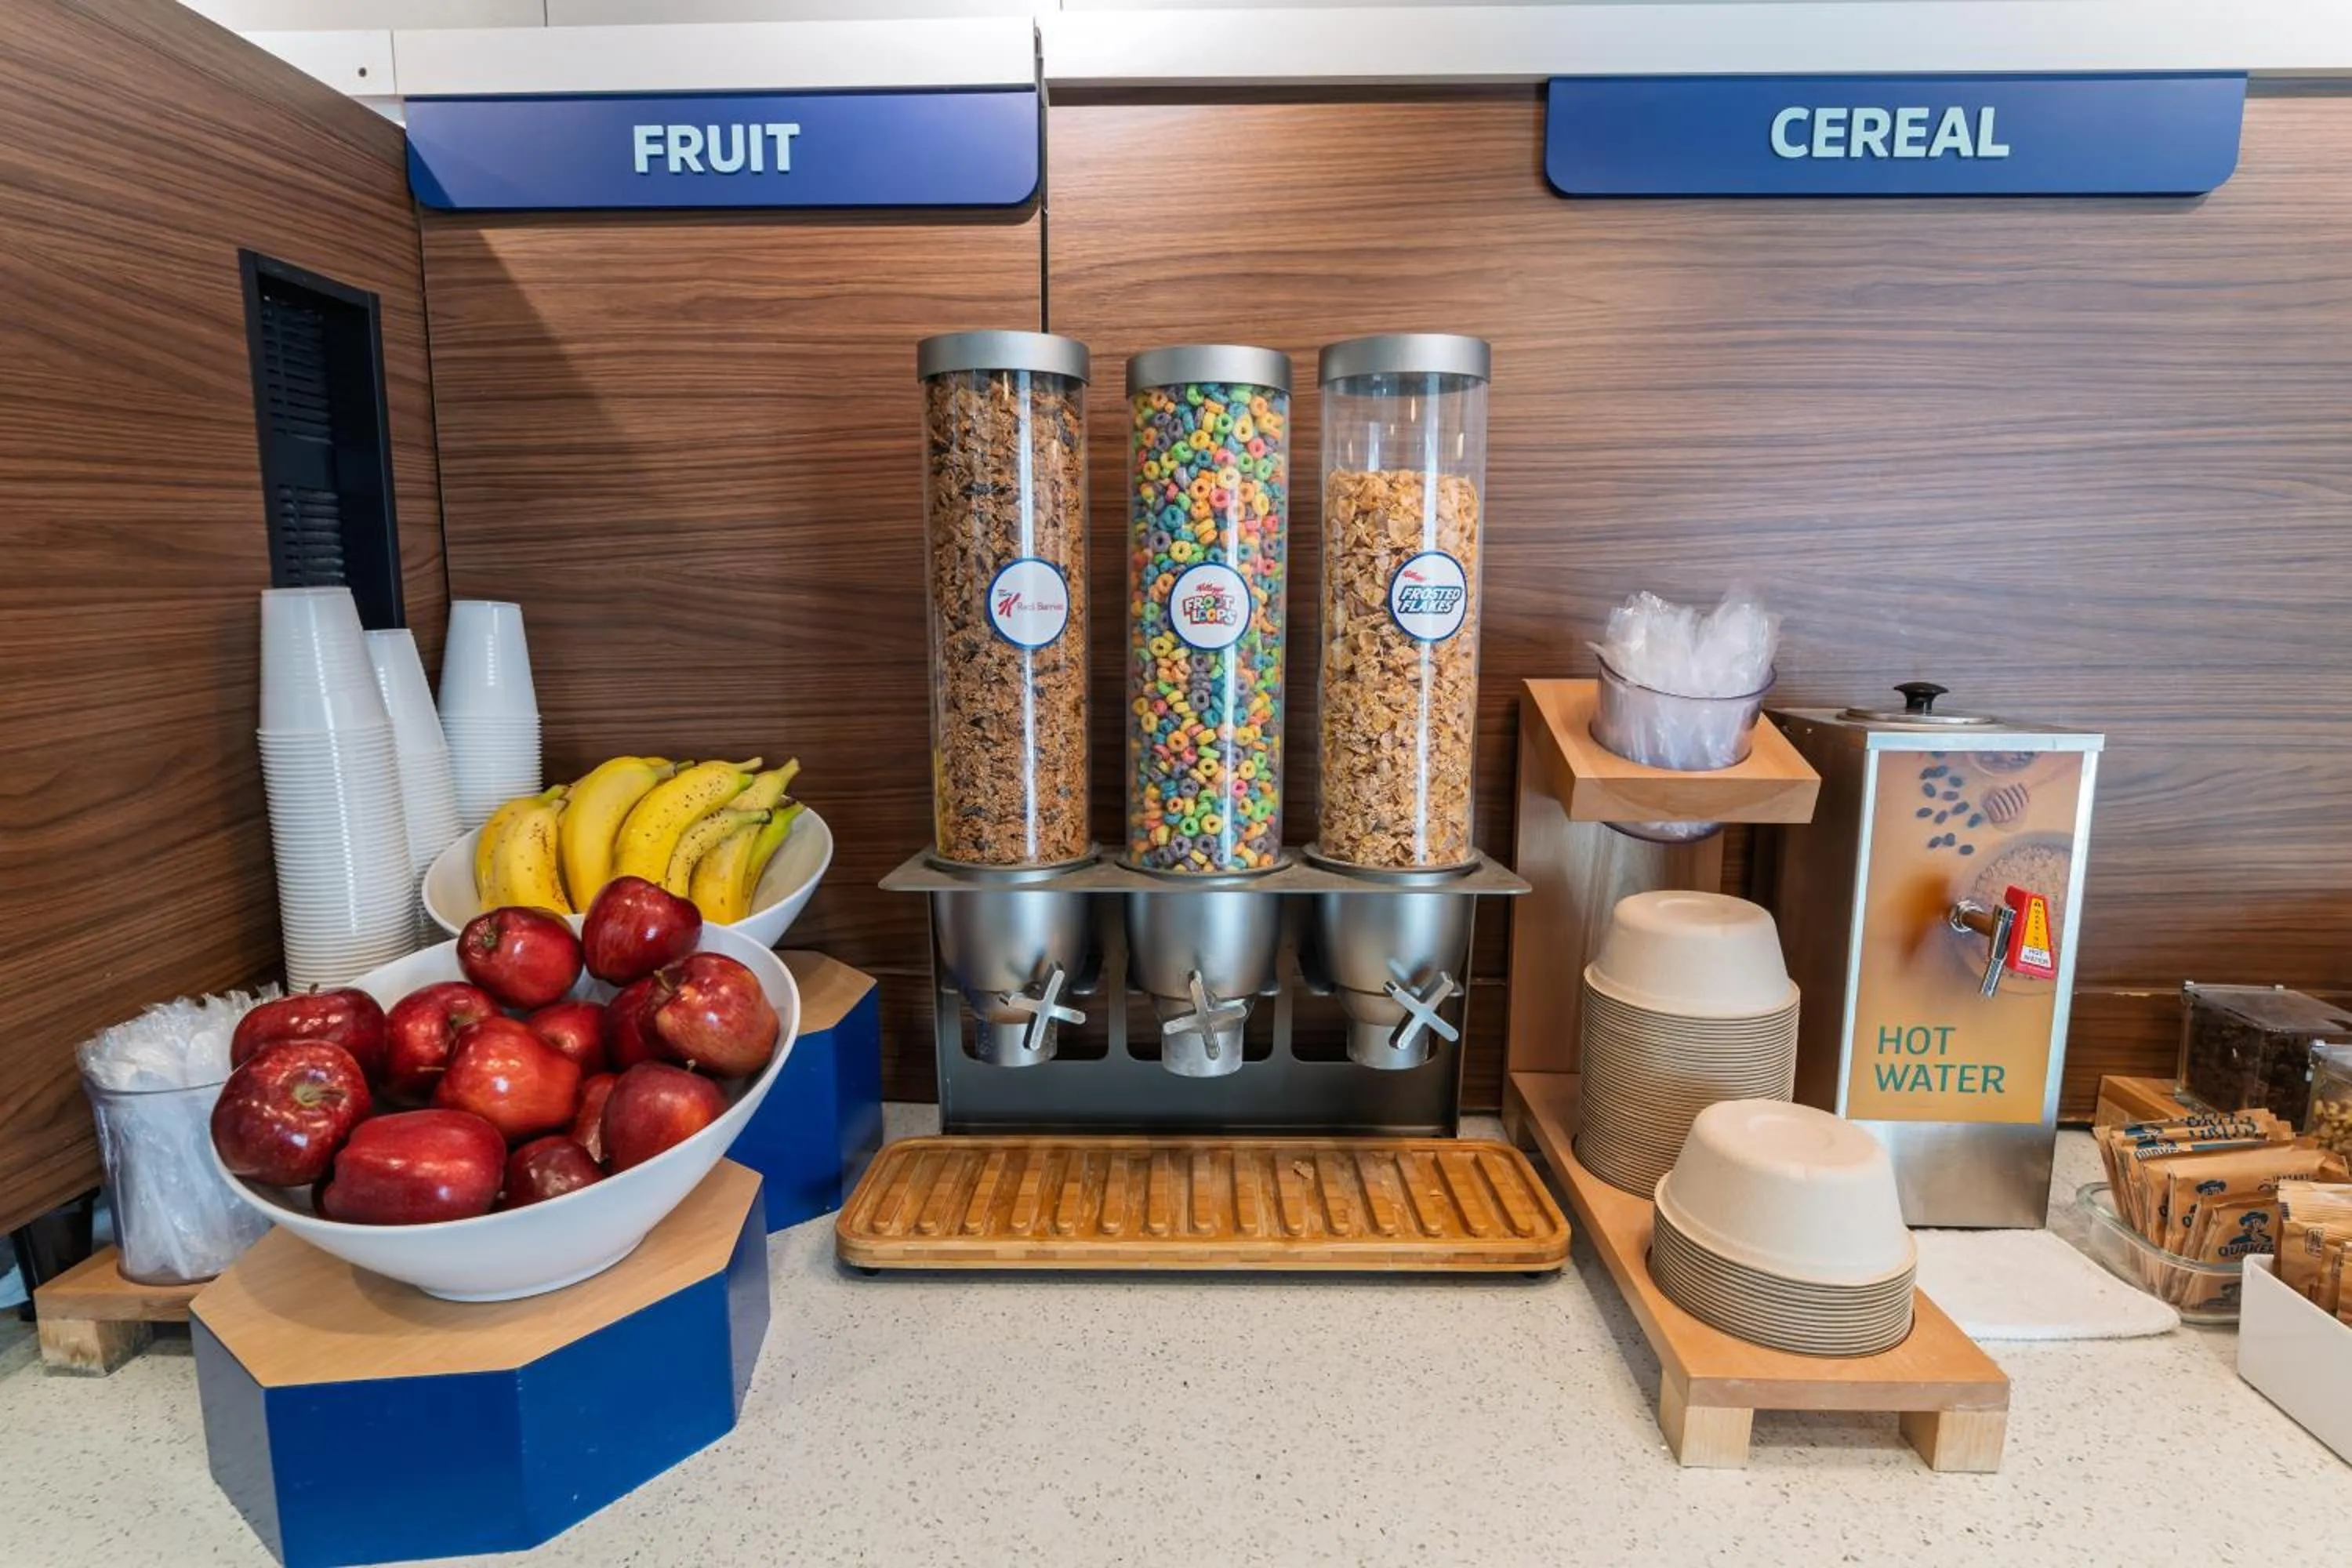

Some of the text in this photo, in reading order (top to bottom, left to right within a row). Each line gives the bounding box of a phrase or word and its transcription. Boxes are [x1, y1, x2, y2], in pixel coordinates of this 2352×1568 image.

[1770, 107, 2009, 158] CEREAL
[633, 123, 800, 172] FRUIT
[1184, 595, 1235, 611] FROOT
[1399, 586, 1462, 601] FROSTED
[1190, 608, 1237, 626] LOOPS
[1399, 600, 1454, 613] FLAKES
[1878, 1026, 1956, 1054] HOT
[1875, 1063, 2005, 1093] WATER
